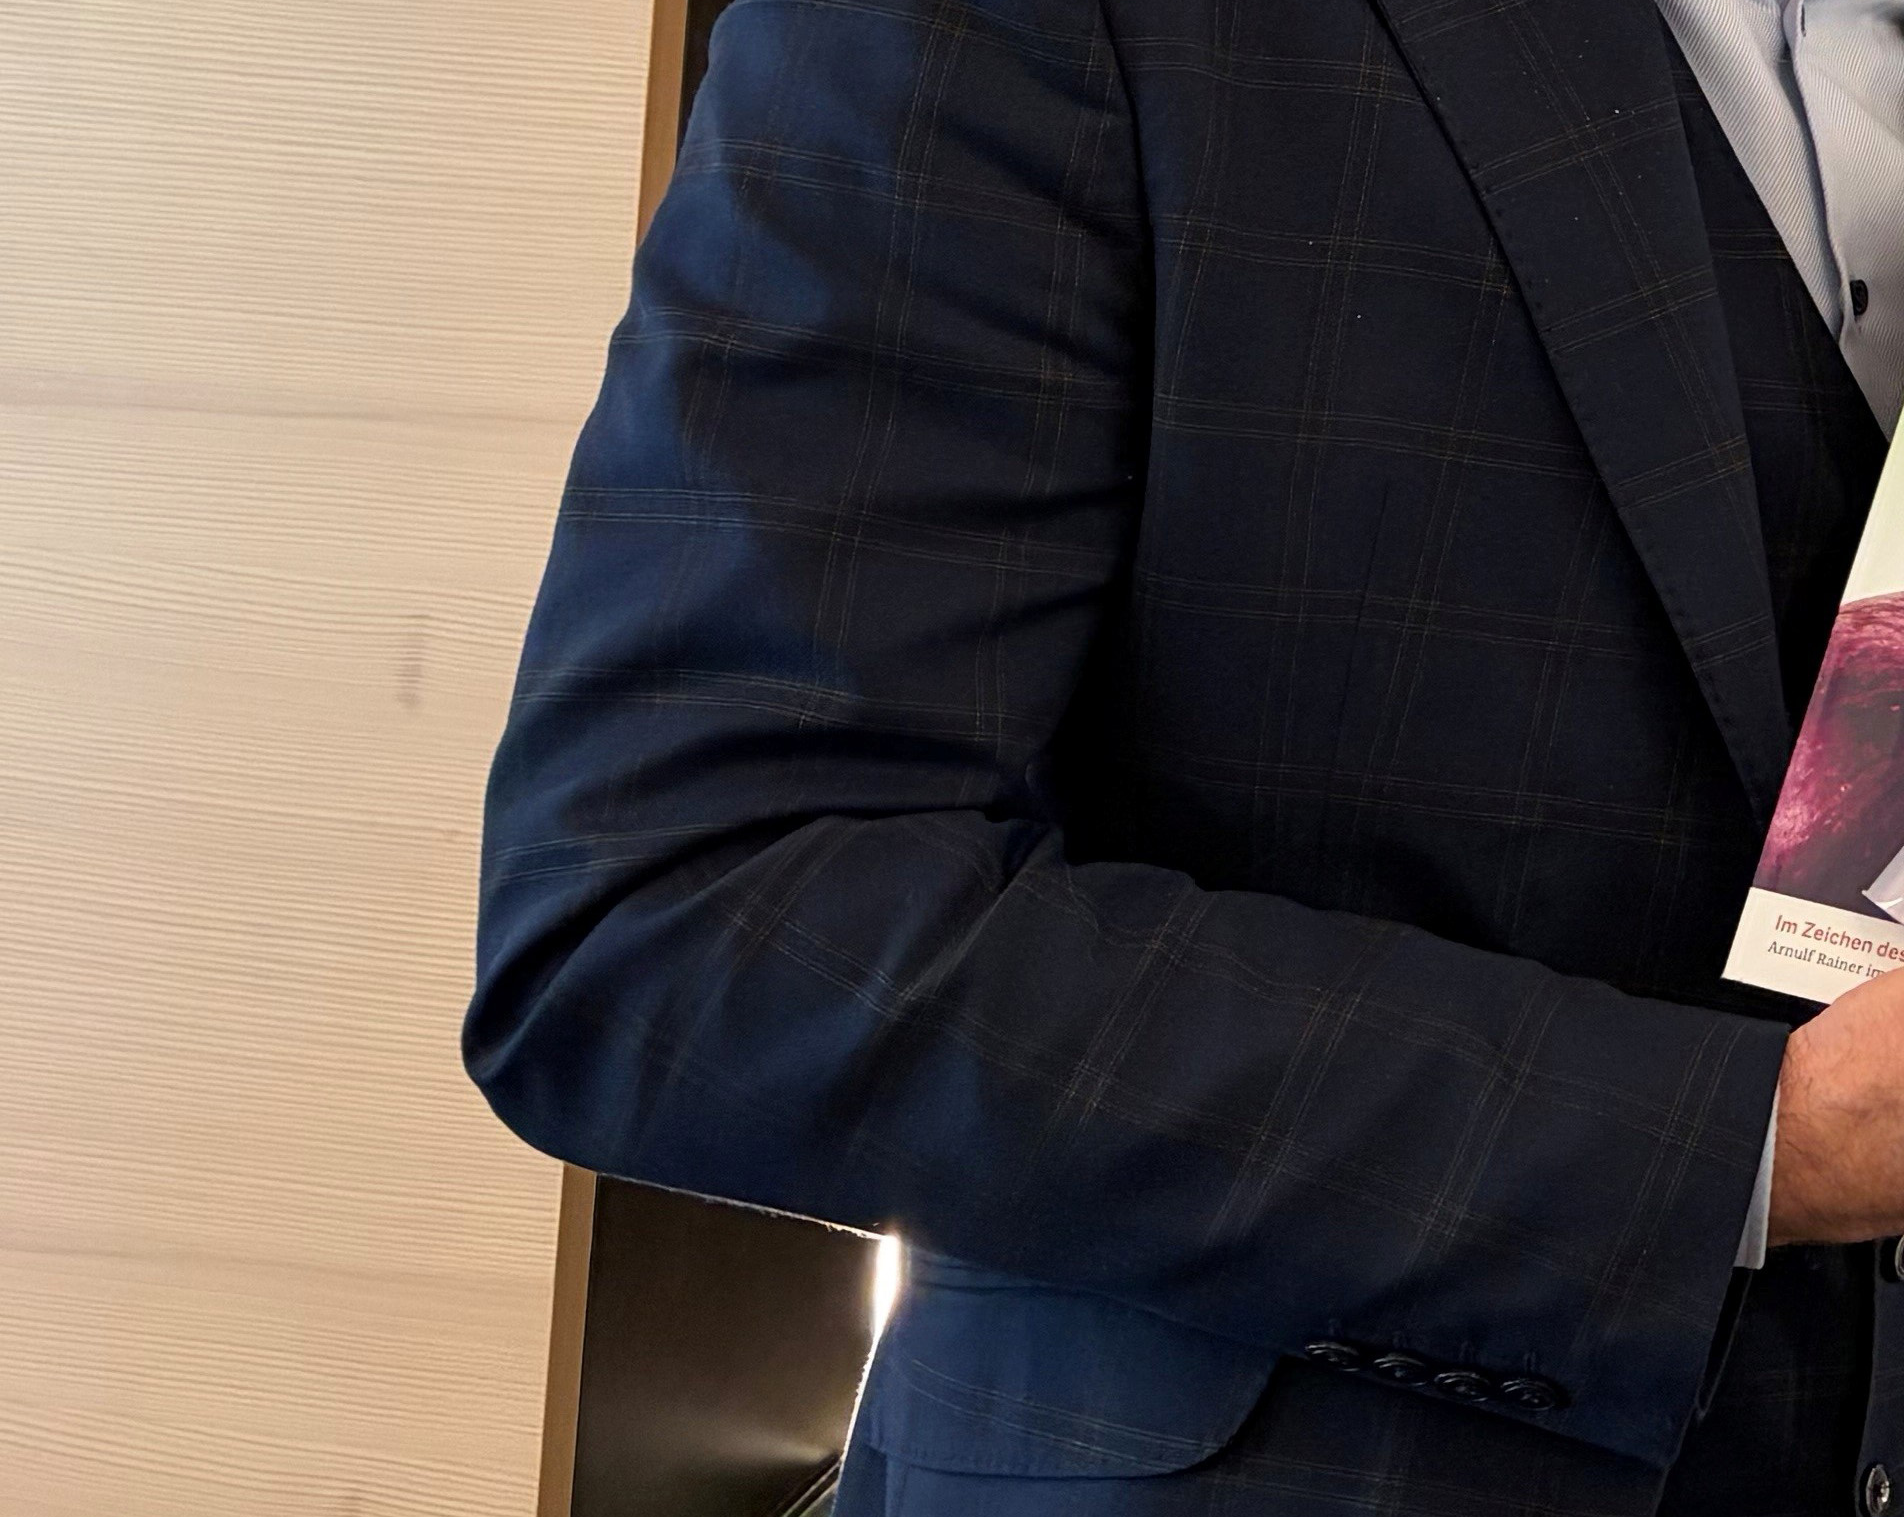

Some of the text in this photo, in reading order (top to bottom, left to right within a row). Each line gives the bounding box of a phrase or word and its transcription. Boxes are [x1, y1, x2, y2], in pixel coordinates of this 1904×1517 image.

[1775, 914, 1798, 934] Im
[1801, 921, 1873, 954] Zeichen
[1767, 941, 1863, 975] Arnulf Rainer
